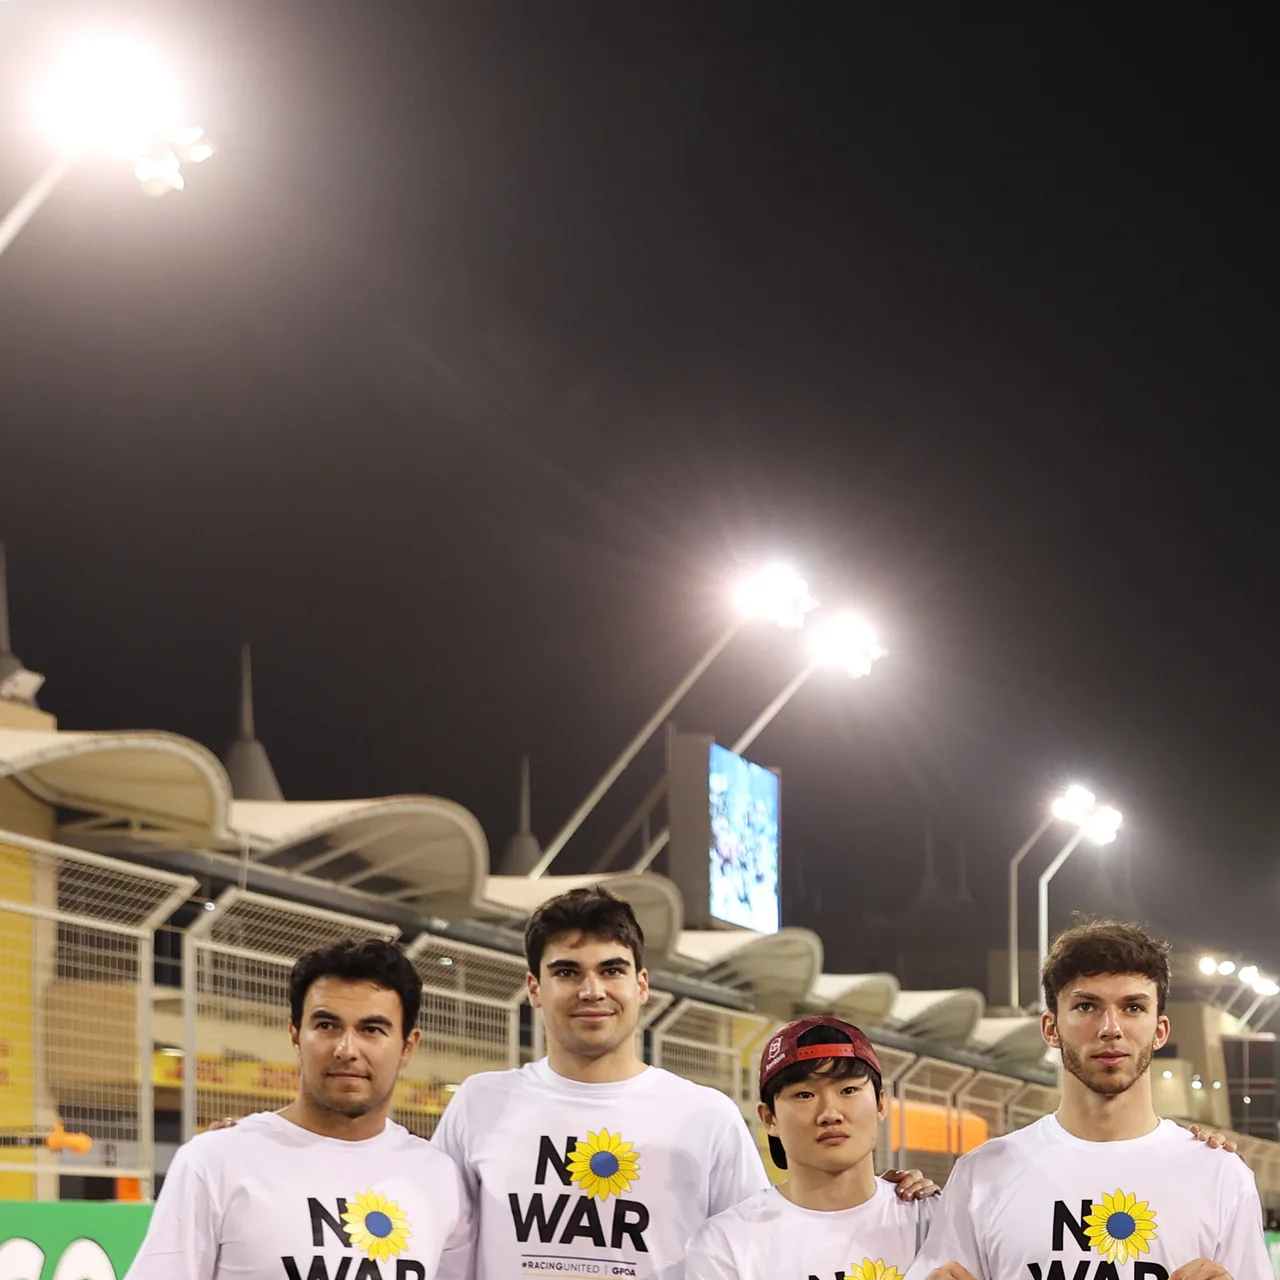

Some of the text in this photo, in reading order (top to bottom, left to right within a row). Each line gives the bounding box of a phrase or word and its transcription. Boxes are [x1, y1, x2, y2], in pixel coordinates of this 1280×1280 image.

[508, 1193, 650, 1253] WAR
[521, 1261, 636, 1277] #RACINGUNITED GPDA
